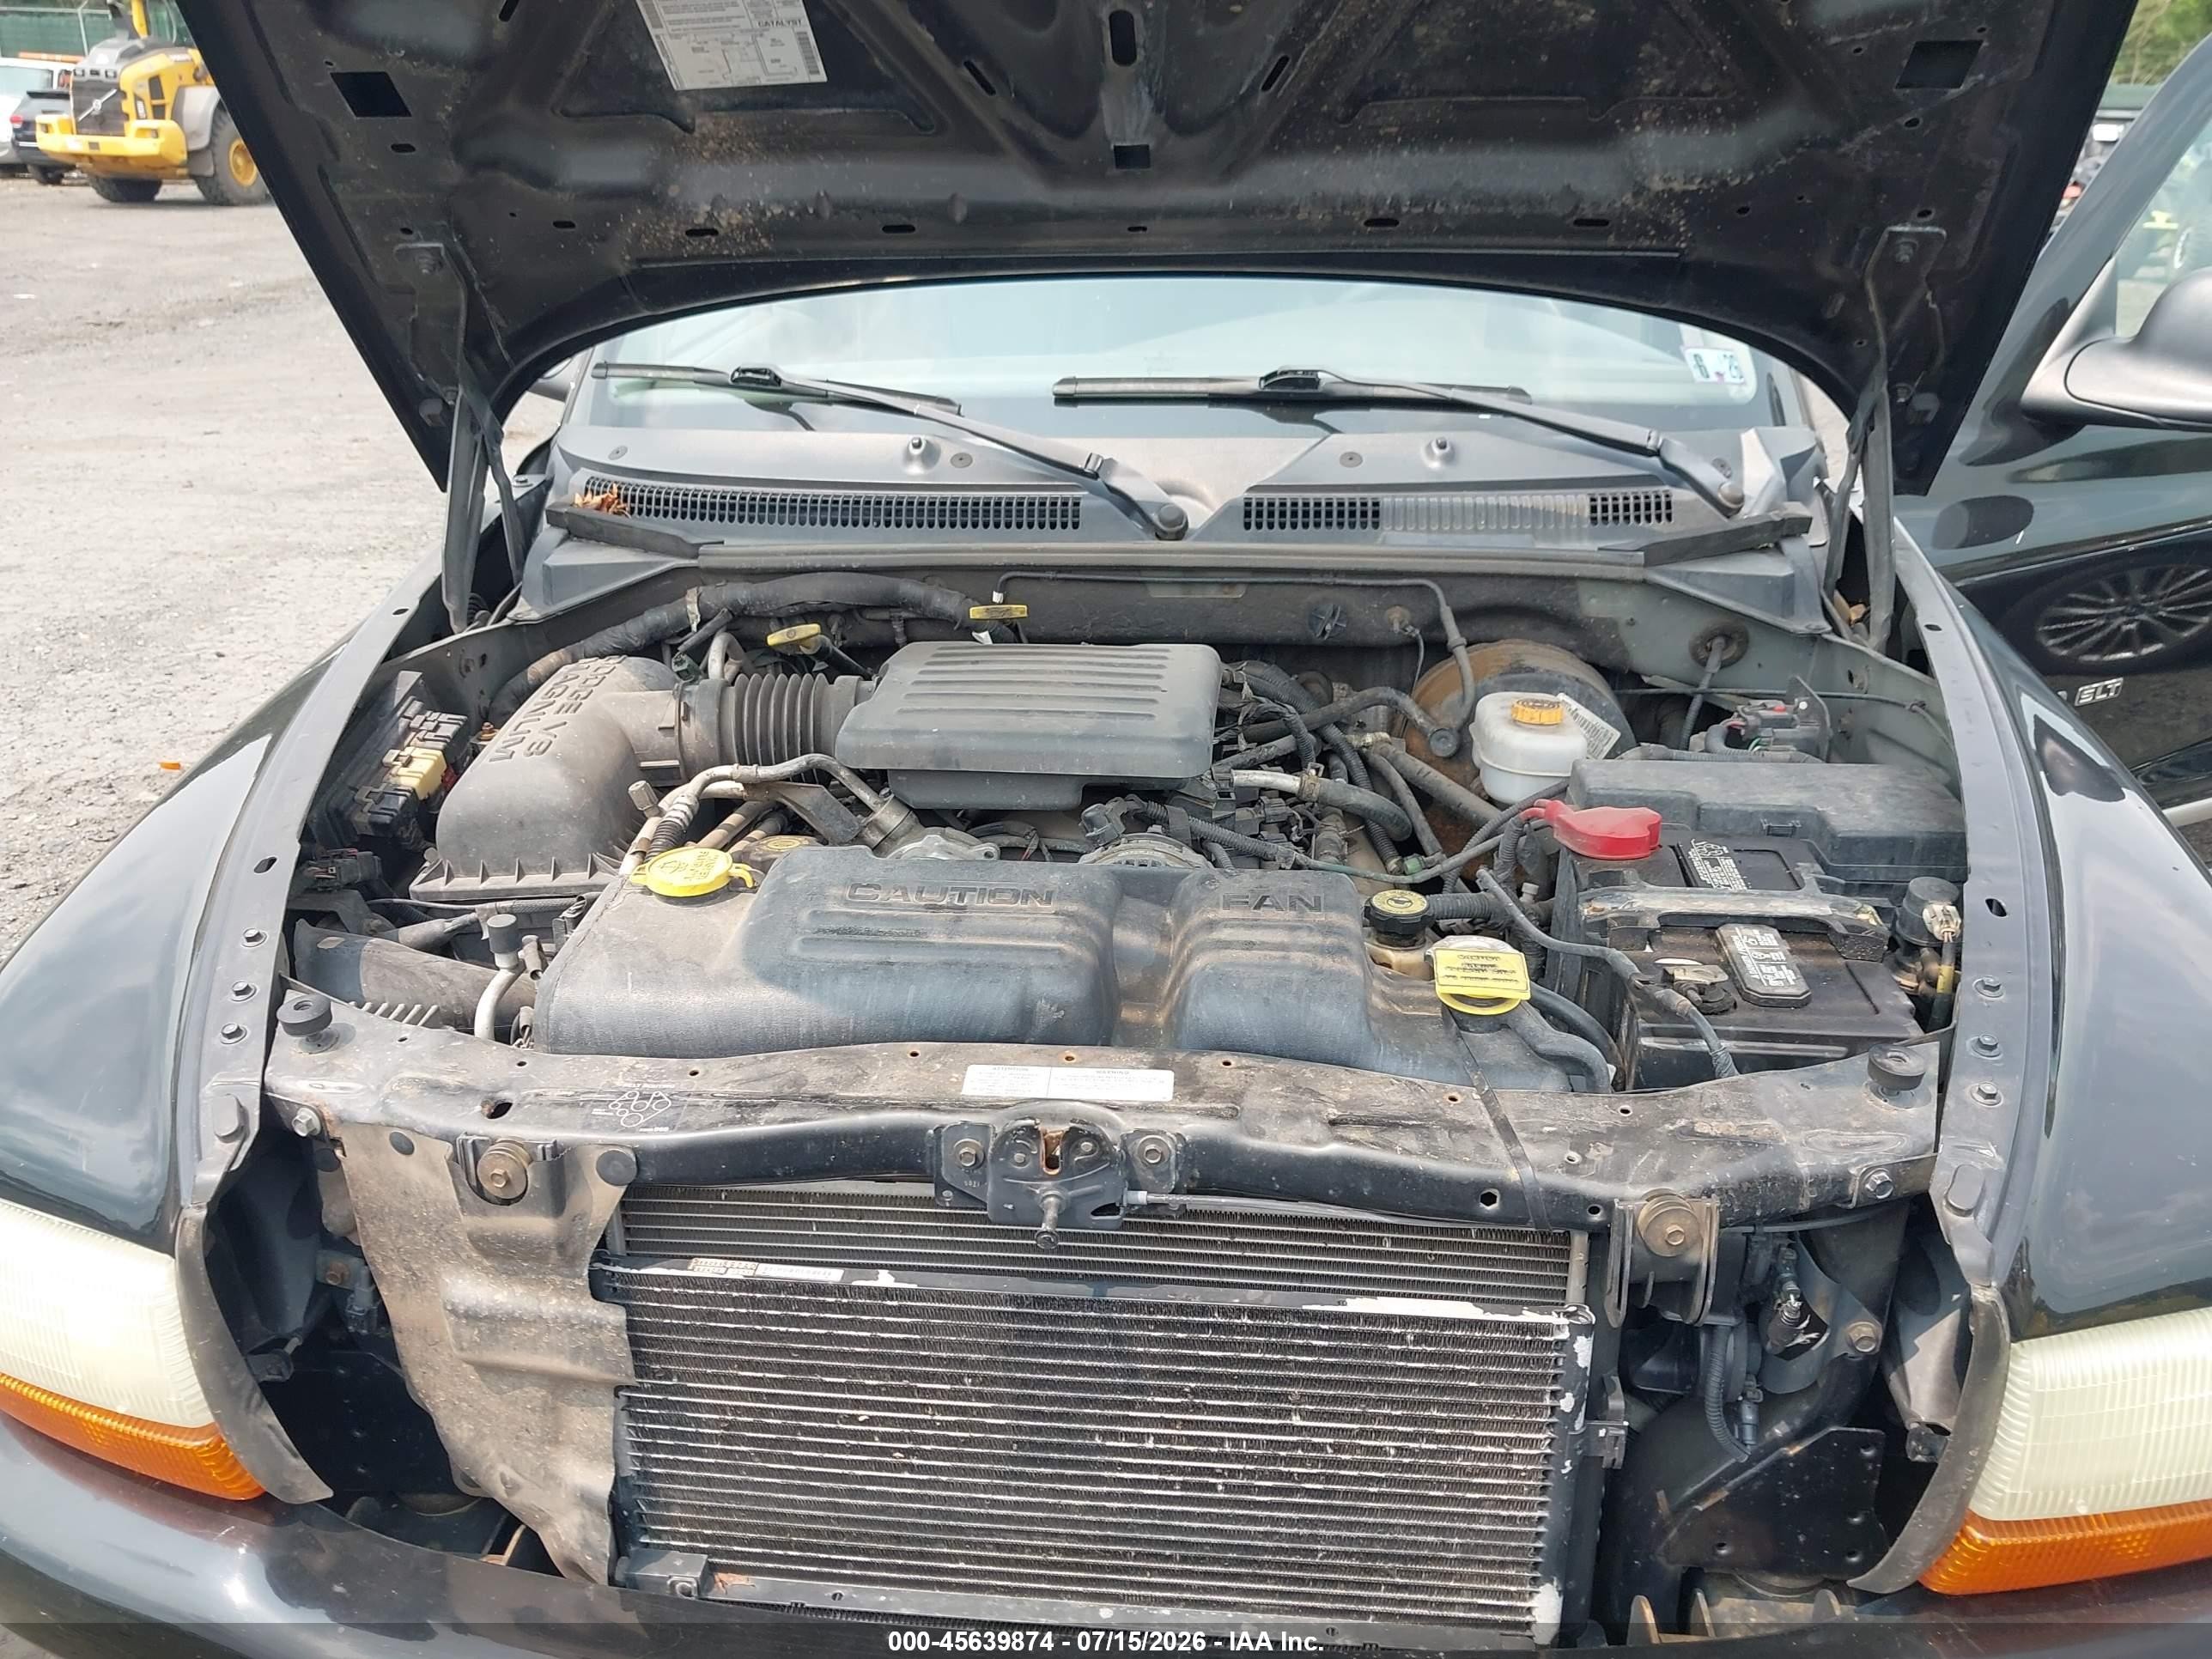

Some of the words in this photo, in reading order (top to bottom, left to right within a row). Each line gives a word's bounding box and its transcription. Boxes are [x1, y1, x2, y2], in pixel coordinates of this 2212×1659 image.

[757, 19, 802, 27] CATALYST
[2079, 682, 2122, 703] SLT
[847, 882, 1055, 907] CAUTION
[1221, 893, 1323, 912] FAN
